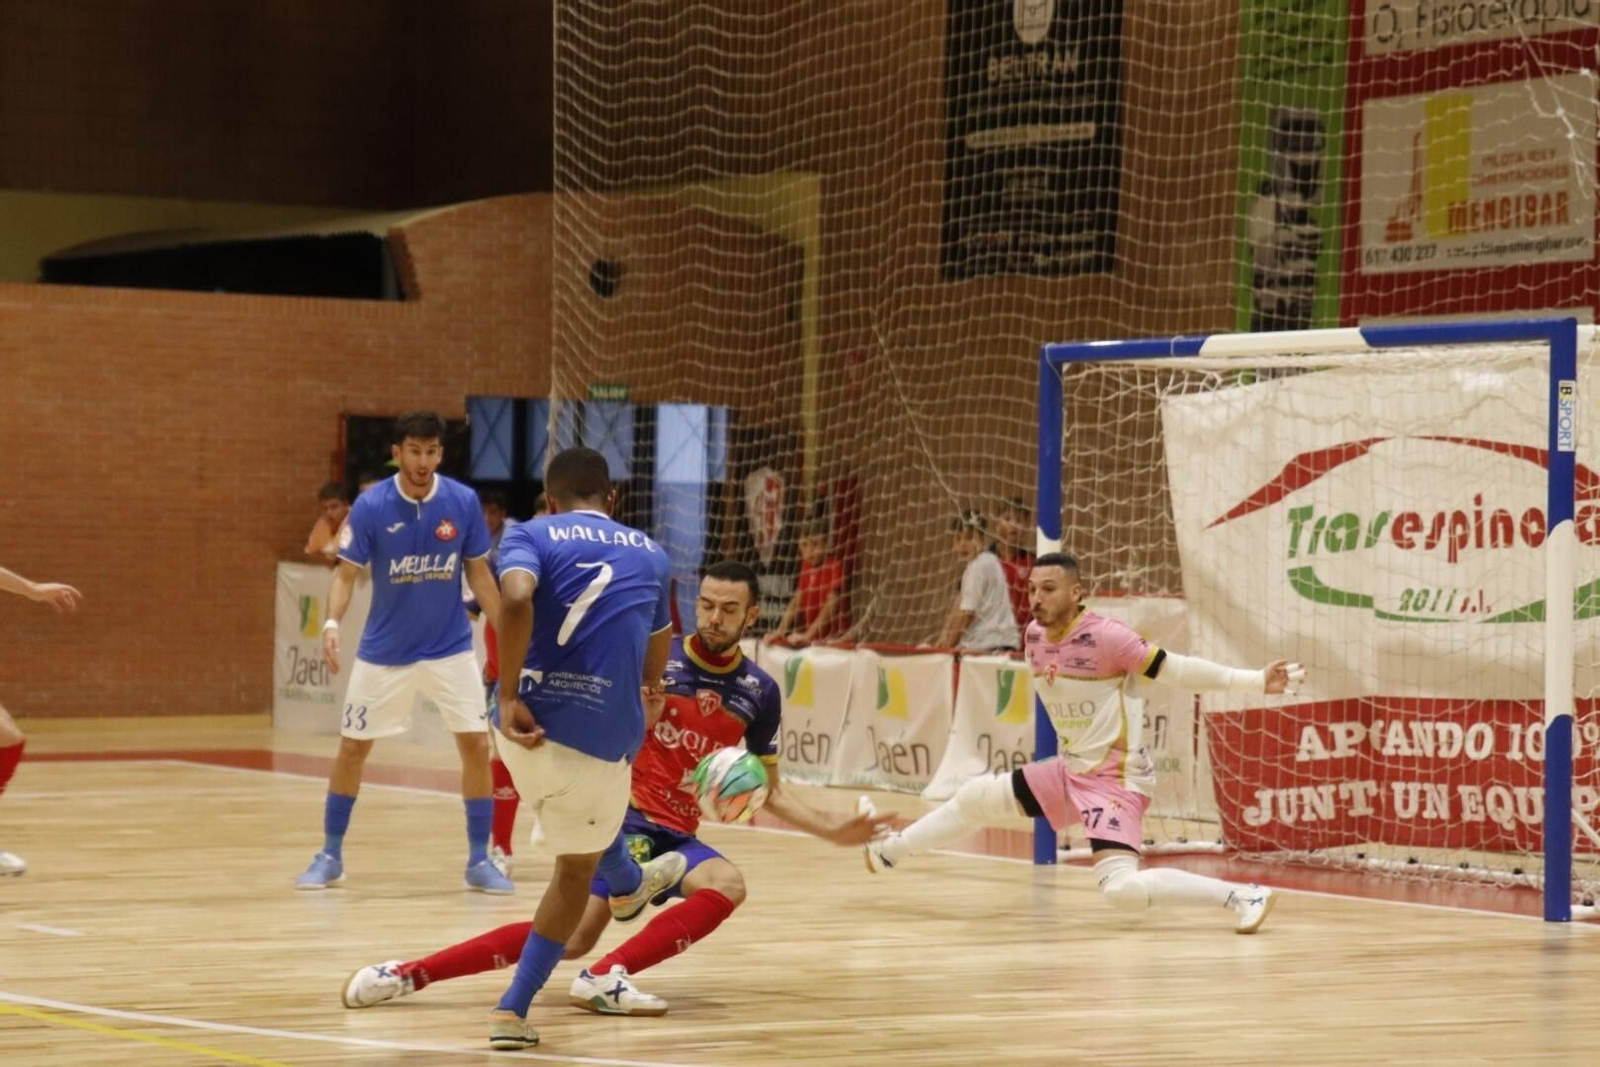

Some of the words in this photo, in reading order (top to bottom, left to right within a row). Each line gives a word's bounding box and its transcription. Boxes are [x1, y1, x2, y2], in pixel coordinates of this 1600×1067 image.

[557, 561, 613, 646] 7
[1399, 588, 1457, 612] 2011
[286, 645, 330, 687] Jaén
[342, 703, 368, 731] 33
[863, 725, 931, 776] Jaén
[1391, 782, 1450, 820] UN
